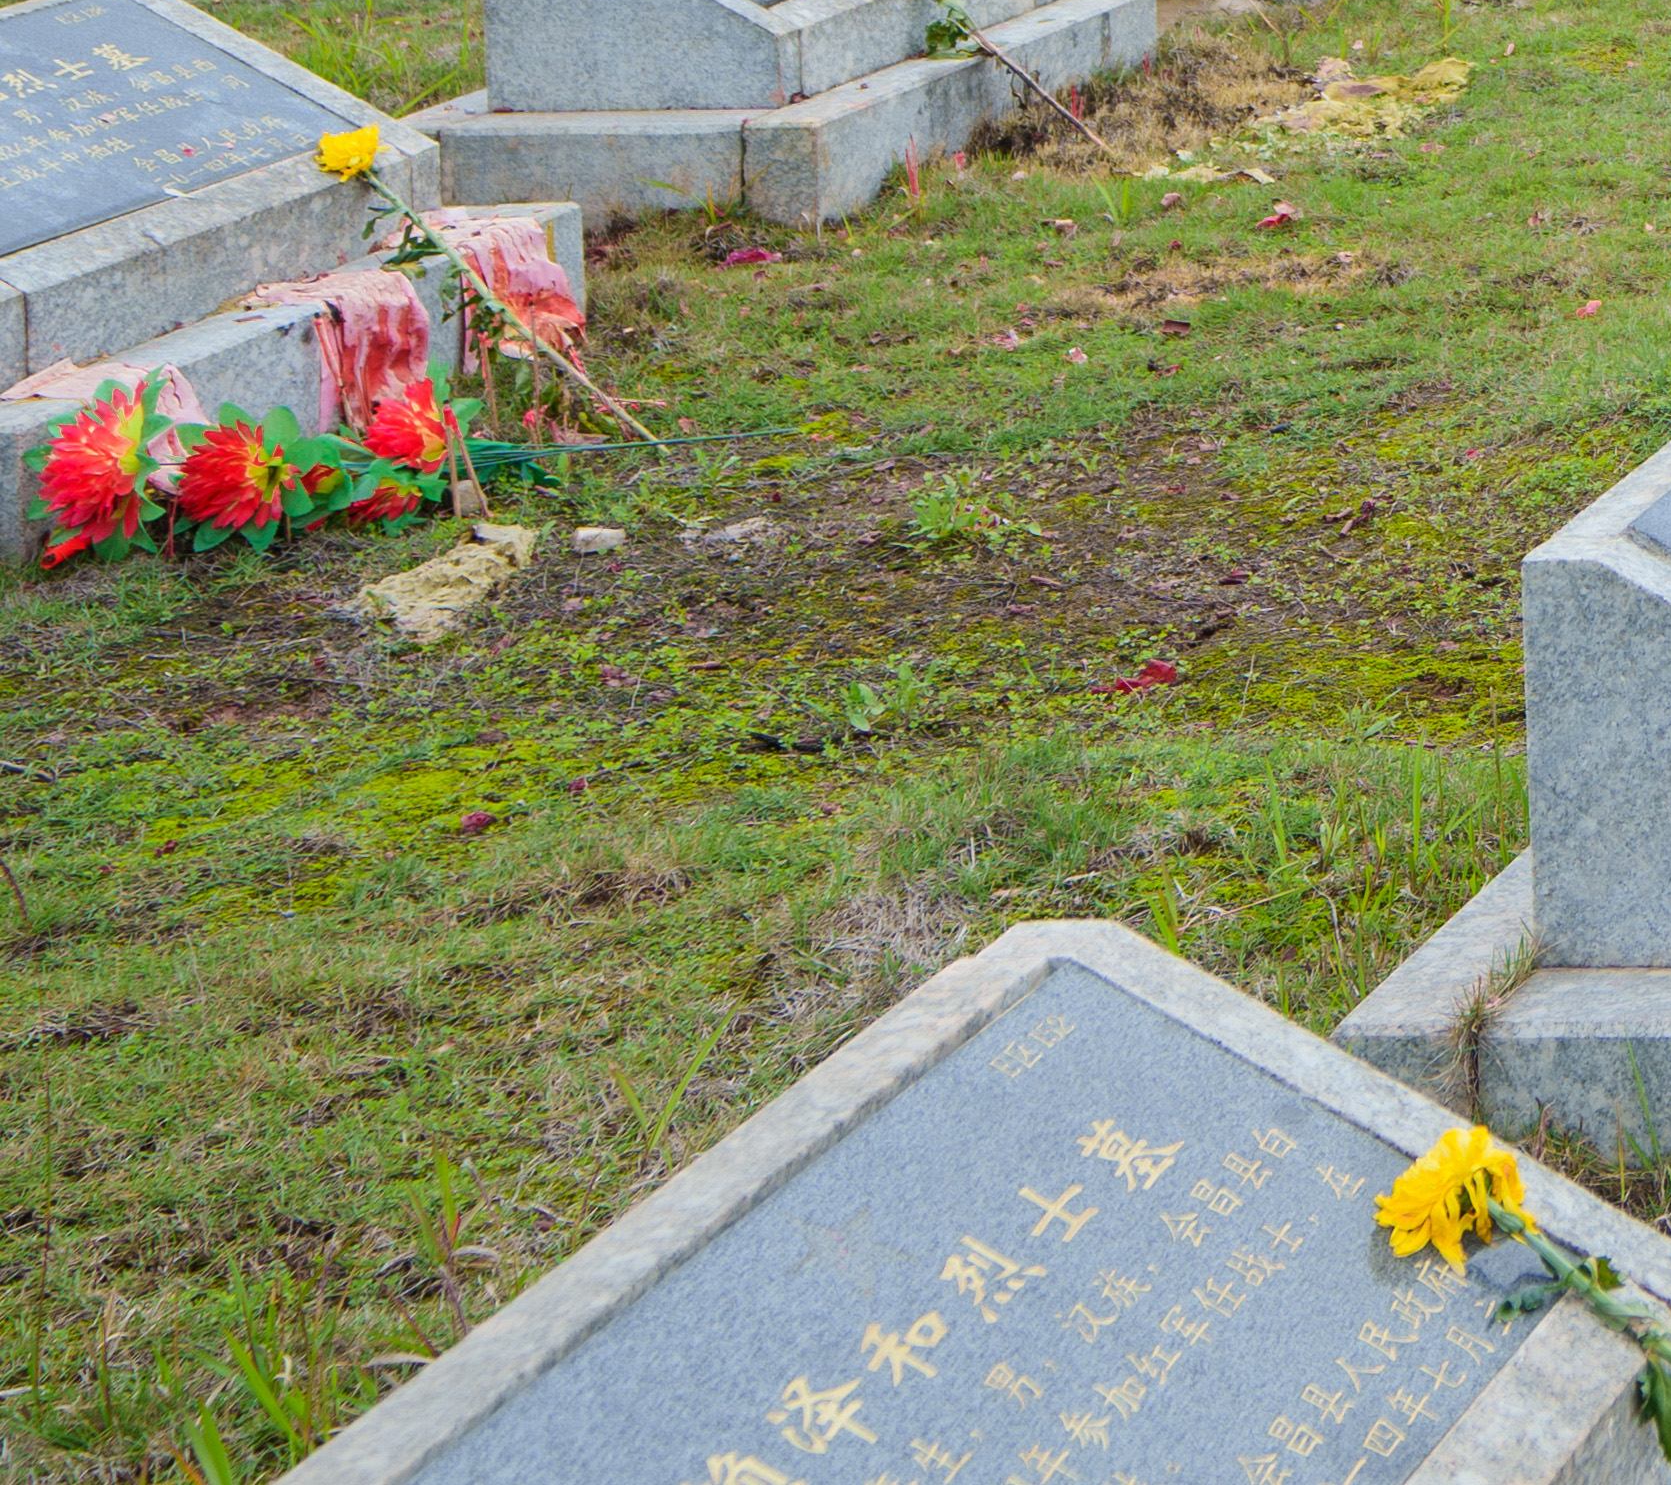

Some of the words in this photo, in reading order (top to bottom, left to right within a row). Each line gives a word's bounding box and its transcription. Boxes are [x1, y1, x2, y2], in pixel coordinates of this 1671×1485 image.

[0, 42, 152, 102] 烈士墓
[988, 1015, 1073, 1078] E区152
[1006, 1162, 1367, 1485] 年参加红军任战士，在
